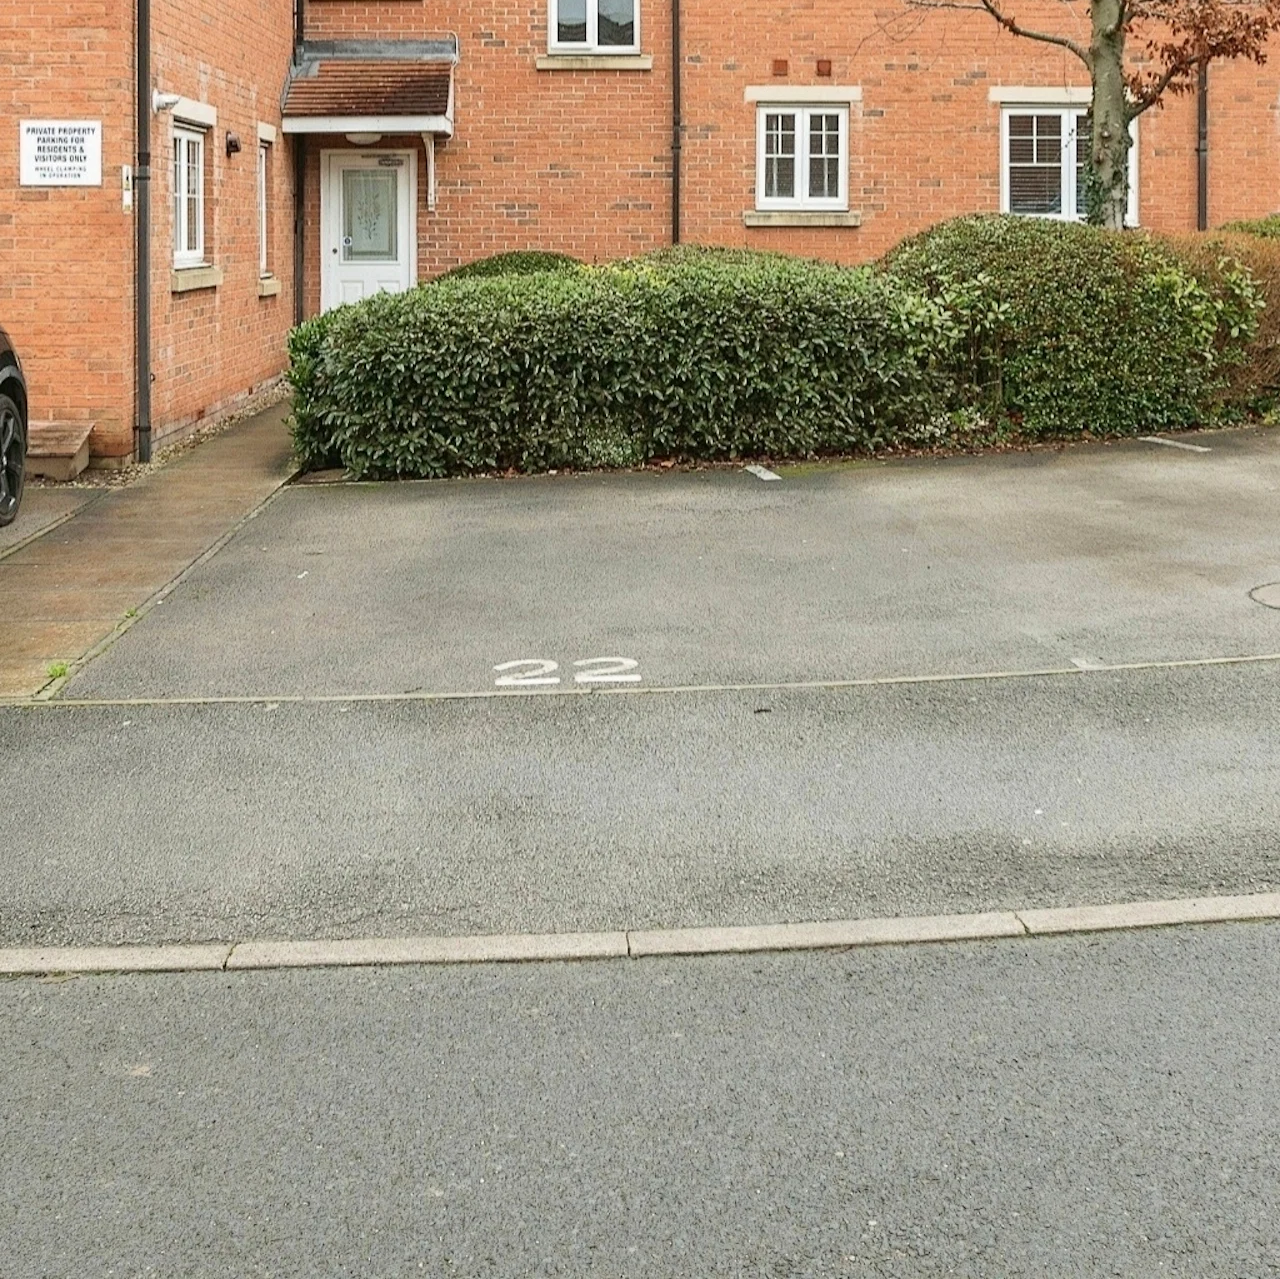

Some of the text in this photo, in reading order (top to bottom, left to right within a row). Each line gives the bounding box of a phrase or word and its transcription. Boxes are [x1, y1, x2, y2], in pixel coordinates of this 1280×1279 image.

[26, 127, 96, 135] PRIVATE PROPERTY
[493, 656, 642, 686] 22
